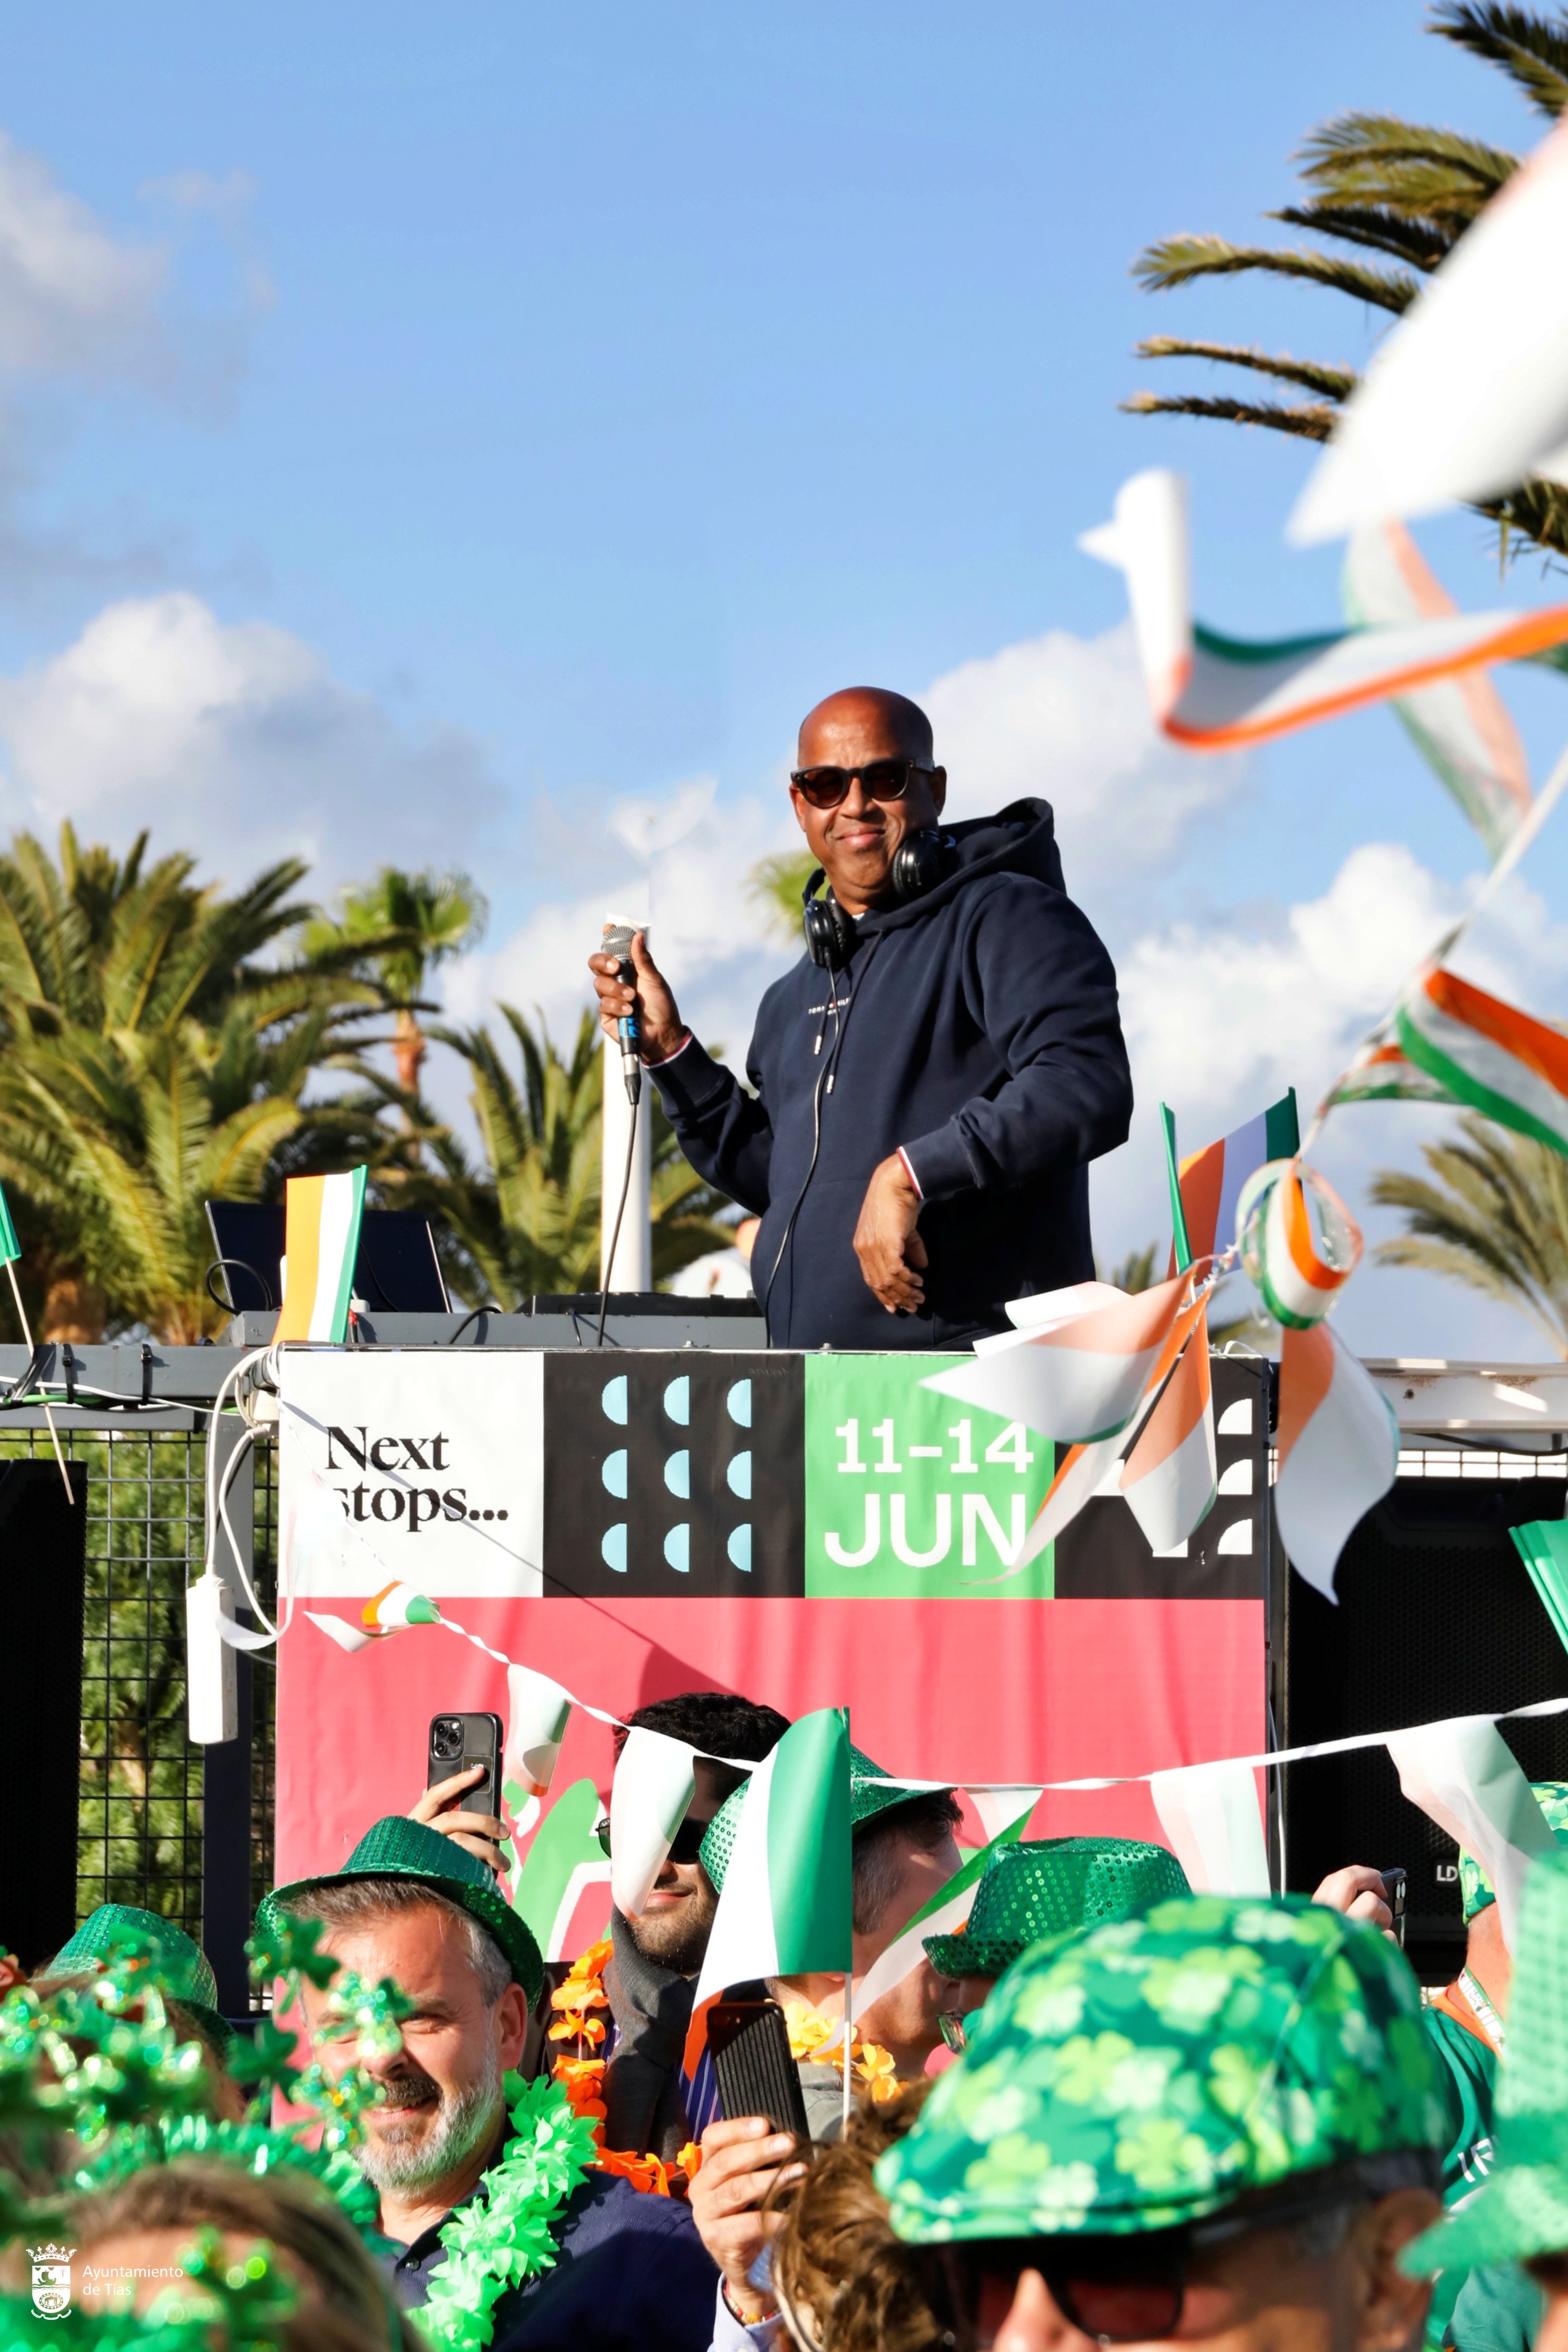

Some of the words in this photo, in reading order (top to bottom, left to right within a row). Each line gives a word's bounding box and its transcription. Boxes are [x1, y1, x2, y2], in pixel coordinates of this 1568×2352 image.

[324, 1426, 450, 1471] Next
[836, 1418, 1034, 1474] 11-14
[825, 1493, 1026, 1569] JUN
[1436, 1864, 1459, 1882] LD
